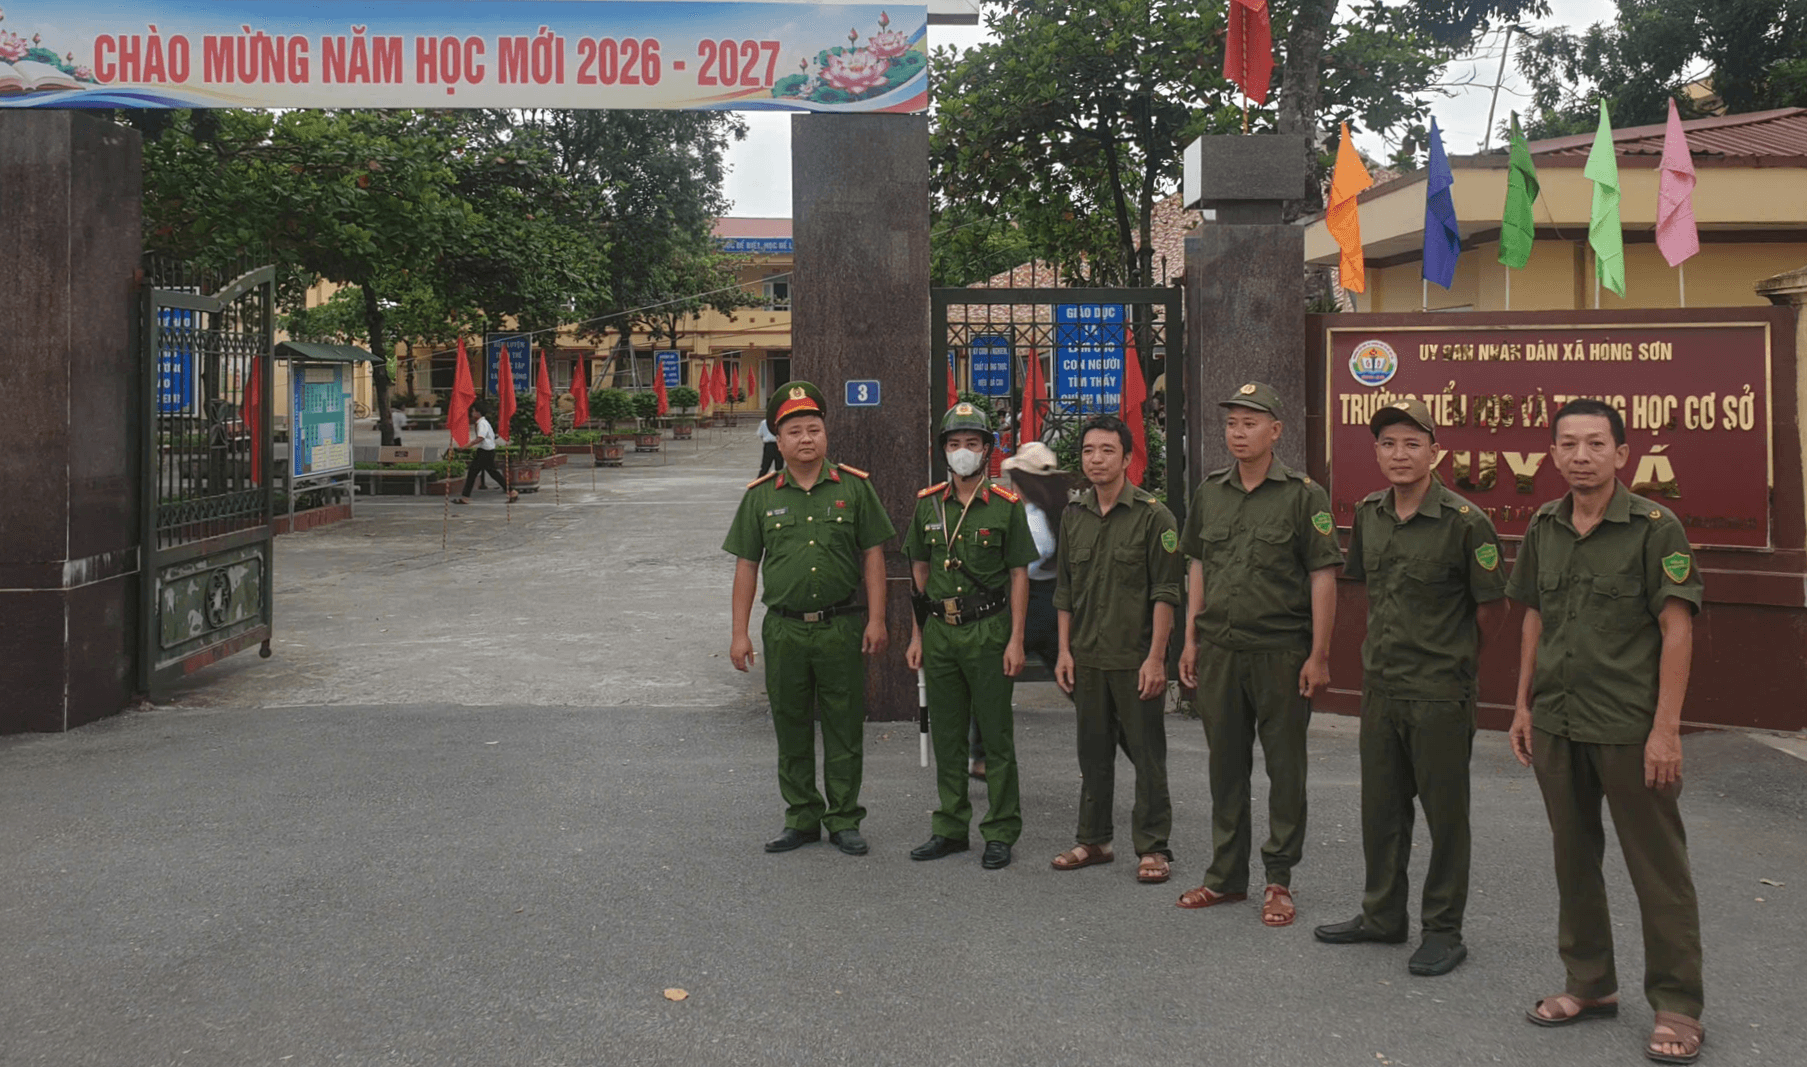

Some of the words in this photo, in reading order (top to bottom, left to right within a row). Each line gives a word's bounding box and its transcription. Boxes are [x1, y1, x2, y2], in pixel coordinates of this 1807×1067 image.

[94, 25, 191, 84] CHÀO
[203, 25, 310, 84] MỪNG
[322, 26, 404, 84] NĂM
[416, 36, 485, 95] HỌC
[498, 26, 564, 84] MỚI
[577, 37, 661, 85] 2026
[673, 60, 686, 71] -
[697, 39, 781, 87] 2027
[1525, 339, 1558, 361] DÂN
[1562, 339, 1585, 361] XÃ
[1638, 341, 1673, 361] SƠN
[858, 384, 868, 402] 3
[1473, 394, 1514, 434] HỌC
[1521, 387, 1549, 428] VÀ
[1632, 395, 1679, 436] HỌC
[1684, 392, 1716, 430] CƠ
[1722, 384, 1755, 430] SỞ
